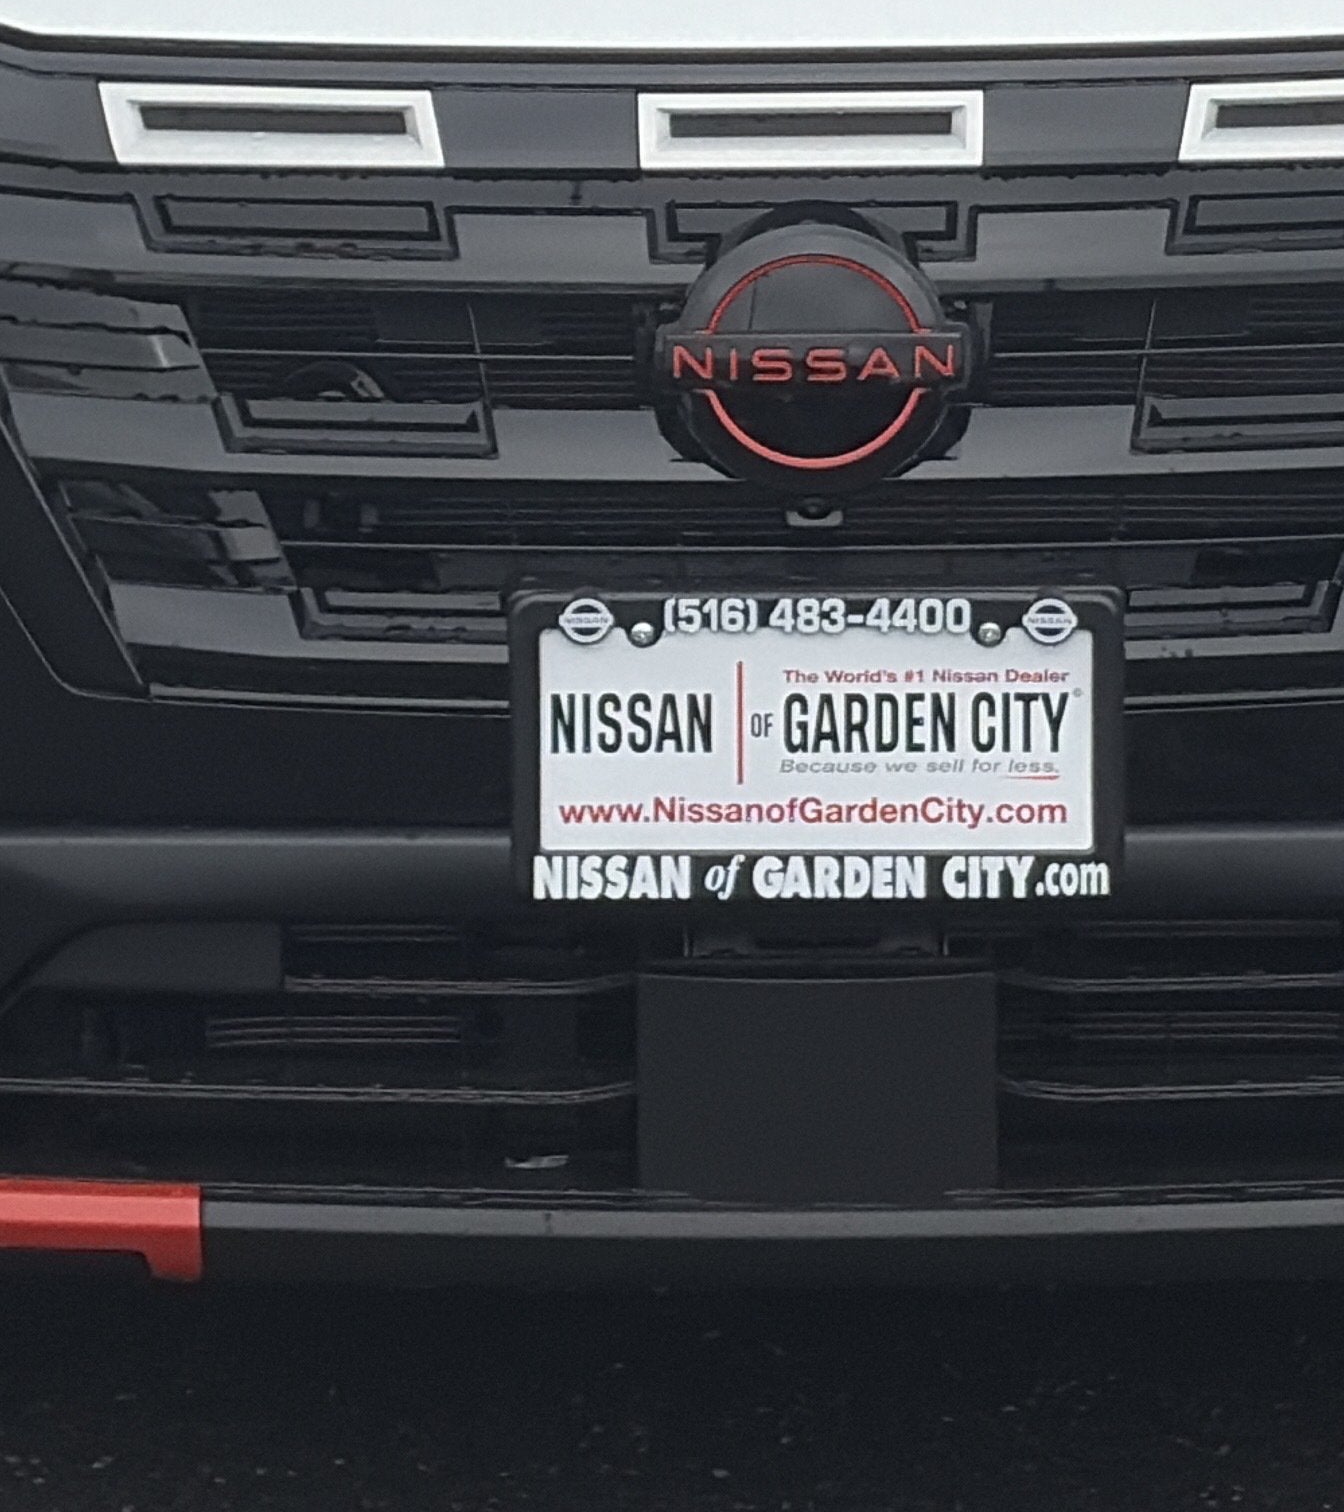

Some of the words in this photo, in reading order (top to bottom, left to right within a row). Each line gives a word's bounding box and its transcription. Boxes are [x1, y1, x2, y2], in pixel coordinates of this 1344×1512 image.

[672, 343, 955, 381] NISSAN
[663, 597, 757, 633] (516)
[769, 597, 971, 634] 483-4400
[783, 669, 818, 683] The
[824, 669, 897, 684] World's
[904, 669, 925, 683] #1
[932, 669, 998, 683] Nissan
[1005, 669, 1069, 683] Dealer
[550, 692, 713, 754] NISSAN
[750, 712, 773, 738] OF
[783, 691, 956, 754] GARDEN
[970, 691, 1069, 754] CITY
[779, 759, 877, 774] Because
[884, 762, 917, 773] we
[926, 759, 965, 773] sell
[971, 759, 1002, 773] for
[1007, 759, 1060, 774] less.
[558, 796, 1067, 827] www.NissanofGardenCity.com
[533, 855, 691, 900] NISSAN
[704, 854, 745, 901] of
[752, 856, 926, 899] GARDEN
[942, 855, 1110, 899] CITY.com
